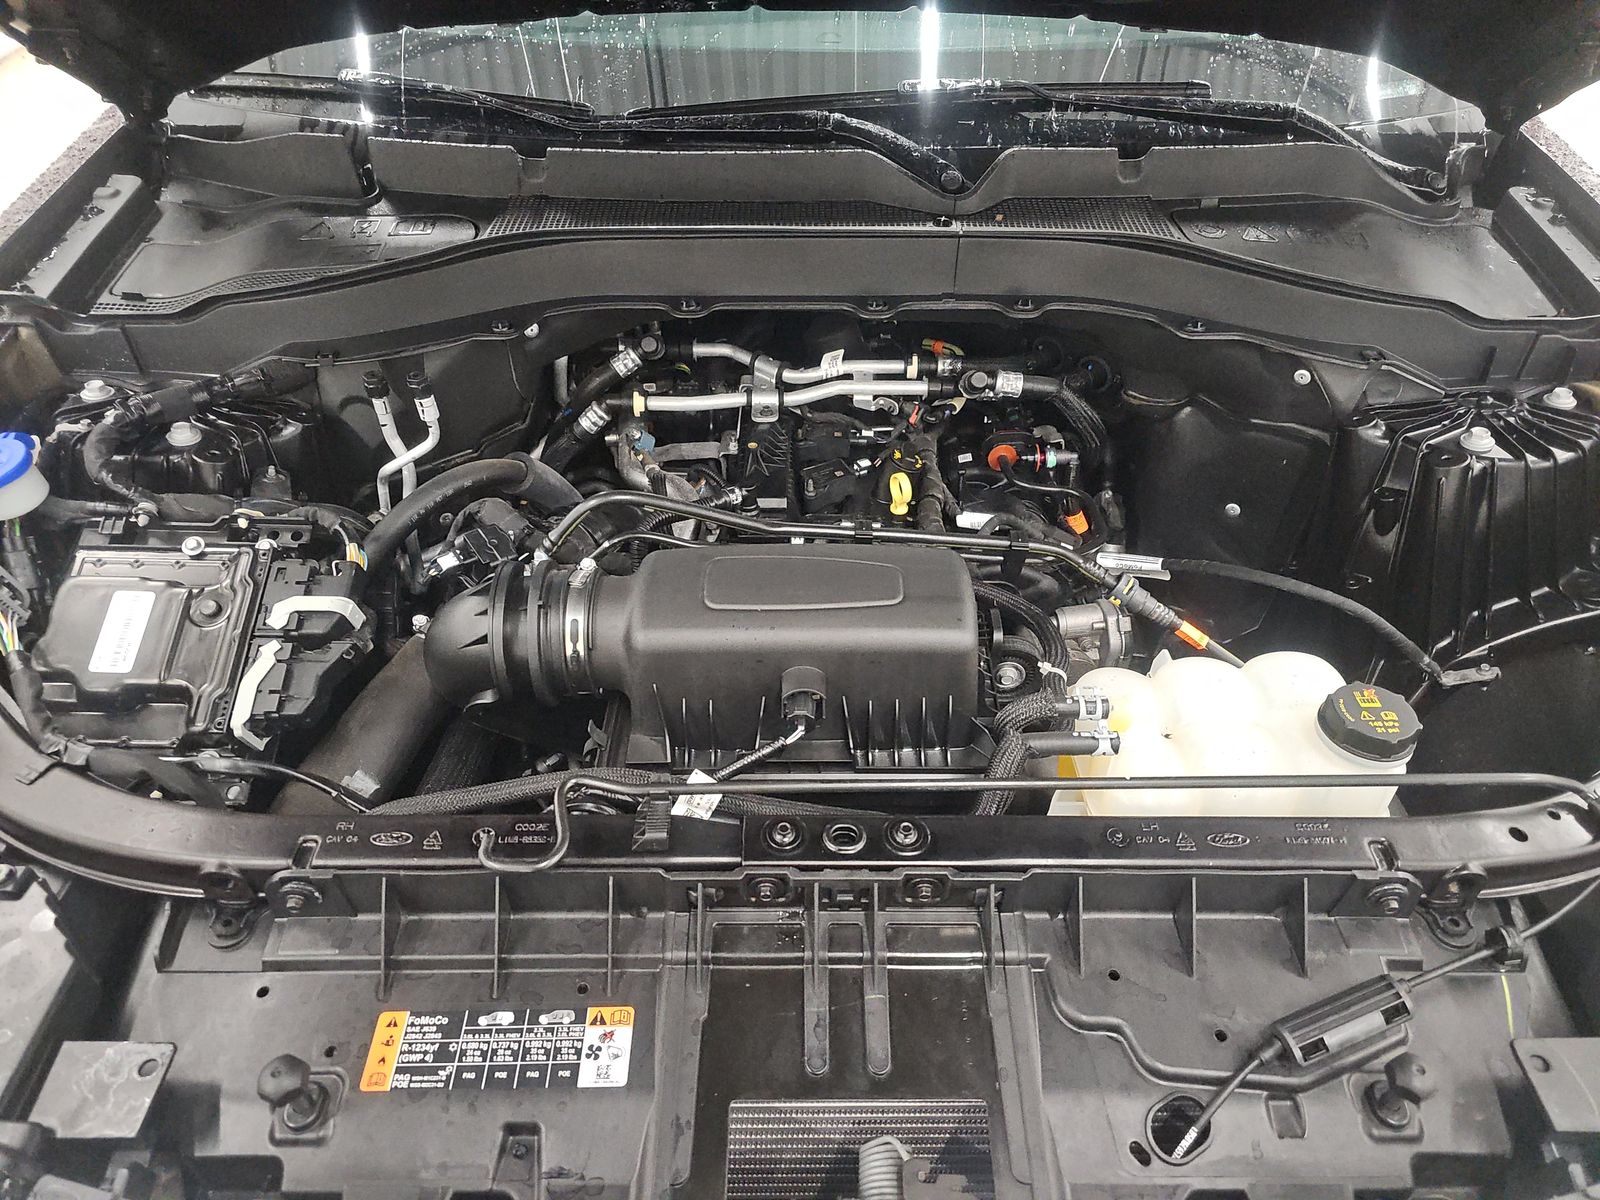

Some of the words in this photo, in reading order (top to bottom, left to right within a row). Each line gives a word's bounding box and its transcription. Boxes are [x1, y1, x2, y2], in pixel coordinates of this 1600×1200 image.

[336, 822, 354, 830] RH
[408, 1016, 449, 1024] FoMoCo
[402, 1043, 440, 1052] R-1234yf
[480, 1042, 488, 1050] kg
[510, 1042, 518, 1050] kg
[543, 1041, 551, 1049] kg
[399, 1054, 424, 1063] (GWP
[424, 1053, 433, 1063] 4)
